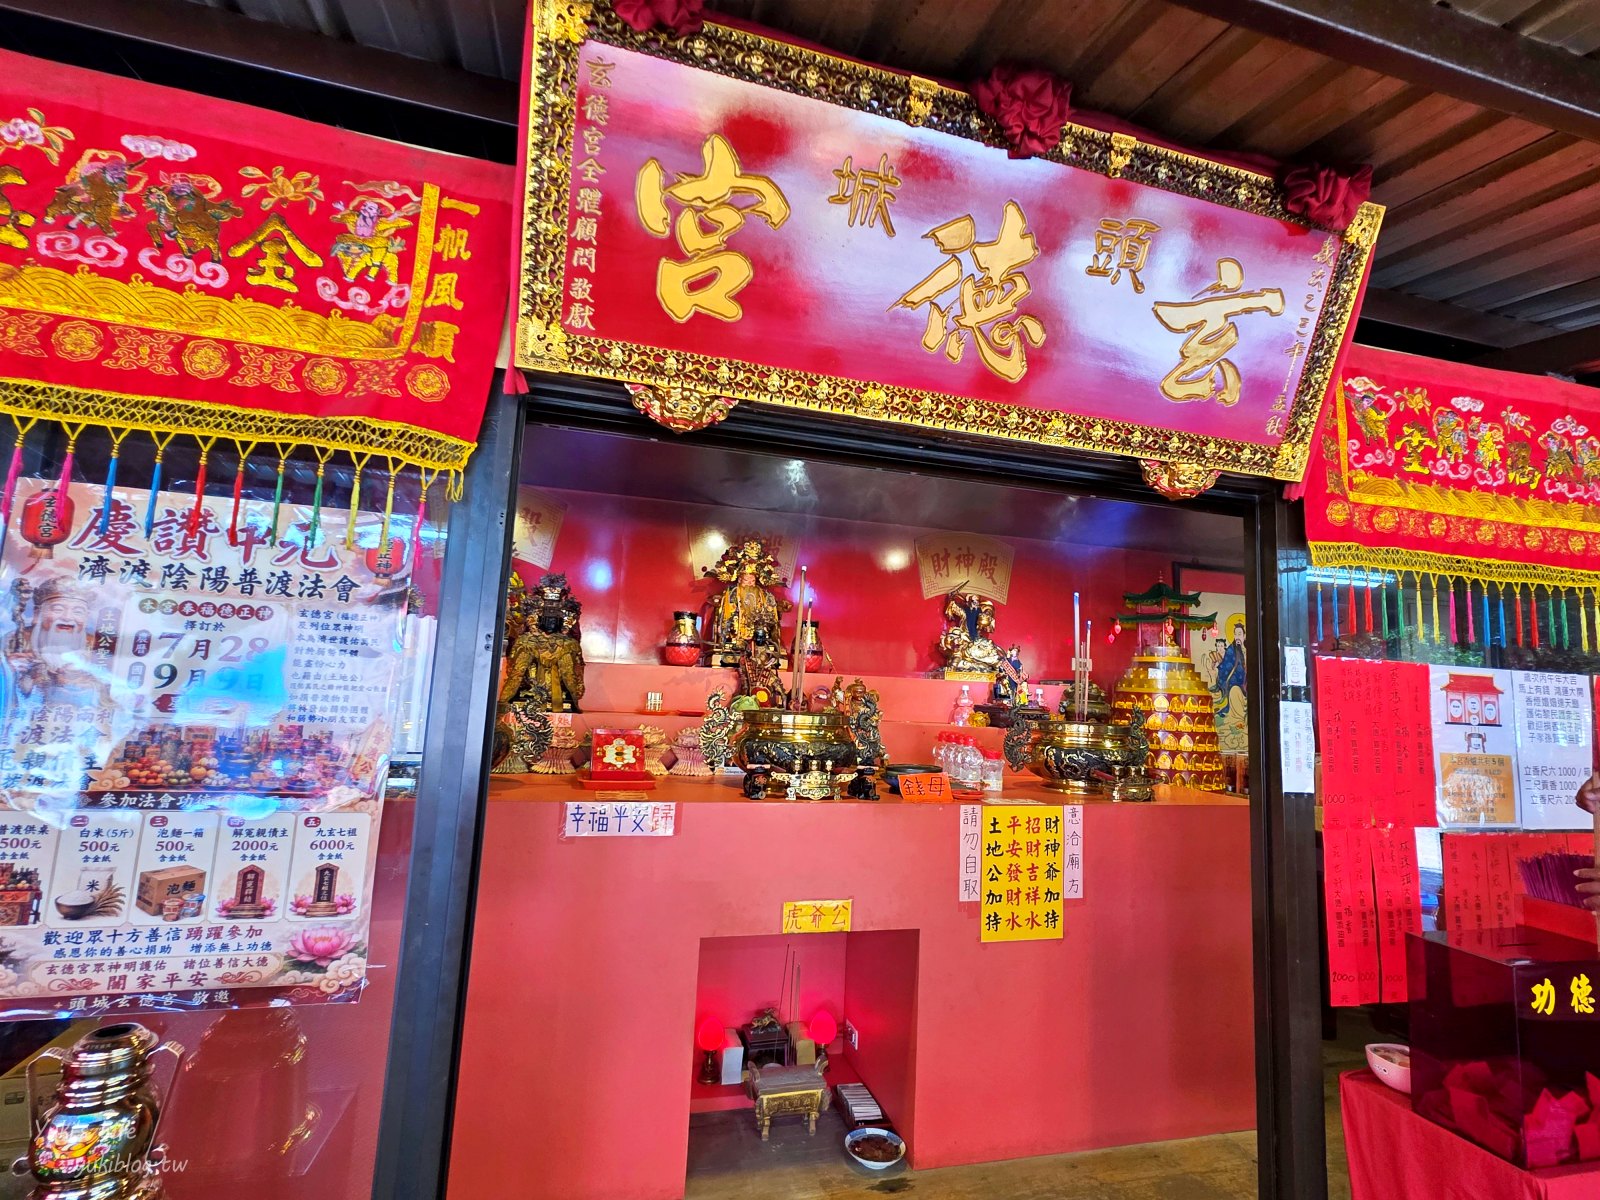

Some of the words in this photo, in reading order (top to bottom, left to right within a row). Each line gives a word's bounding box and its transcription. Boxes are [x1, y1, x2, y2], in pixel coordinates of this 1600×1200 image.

[411, 195, 480, 364] 一帆風順
[39, 492, 59, 538] 玄德宮
[68, 499, 339, 569] 慶讚中元
[930, 546, 999, 586] 財神殿
[79, 555, 361, 603] 濟渡陰陽普渡法會
[141, 598, 274, 621] 本宮奉福德正神
[184, 620, 226, 632] 擇訂於
[97, 610, 119, 667] 土地公聖
[11, 705, 113, 724] 陰陽兩利
[286, 714, 368, 724] 和弱勢小朋友家庭
[1524, 766, 1556, 777] 立香尺六
[1558, 767, 1577, 777] 1000
[903, 776, 946, 797] 錢母
[1324, 793, 1345, 805] 1000
[79, 828, 135, 838] 白米(5斤)
[157, 828, 204, 838] 泡麵一箱
[232, 827, 289, 838] 解冤親債主
[315, 828, 357, 837] 九玄七祖
[78, 840, 120, 852] 500元
[155, 840, 195, 852] 500元
[231, 840, 279, 851] 2000元
[309, 839, 355, 851] 6000元
[963, 806, 979, 900] 請勿自取
[82, 854, 112, 863] 含金紙
[158, 854, 187, 862] 含金紙
[239, 853, 267, 862] 含金紙
[317, 852, 343, 861] 含金紙
[985, 816, 1004, 932] 土地公加持
[1005, 815, 1023, 932] 平安發財水
[1024, 815, 1042, 931] 招財吉祥水
[1043, 815, 1061, 930] 財神爺加持
[86, 879, 100, 893] 米
[166, 880, 196, 895] 泡麵
[784, 904, 849, 931] 虎爺公
[42, 924, 263, 946] 歡迎眾十方善信踴躍參加
[53, 944, 172, 959] 感恩你的善心捐助
[189, 942, 273, 954] 增添無上功德
[45, 959, 167, 976] 玄德宮眾神明護佑
[183, 956, 269, 970] 諸位善信大德
[68, 992, 177, 1011] 頭城玄德宮
[1531, 973, 1596, 1016] 功德
